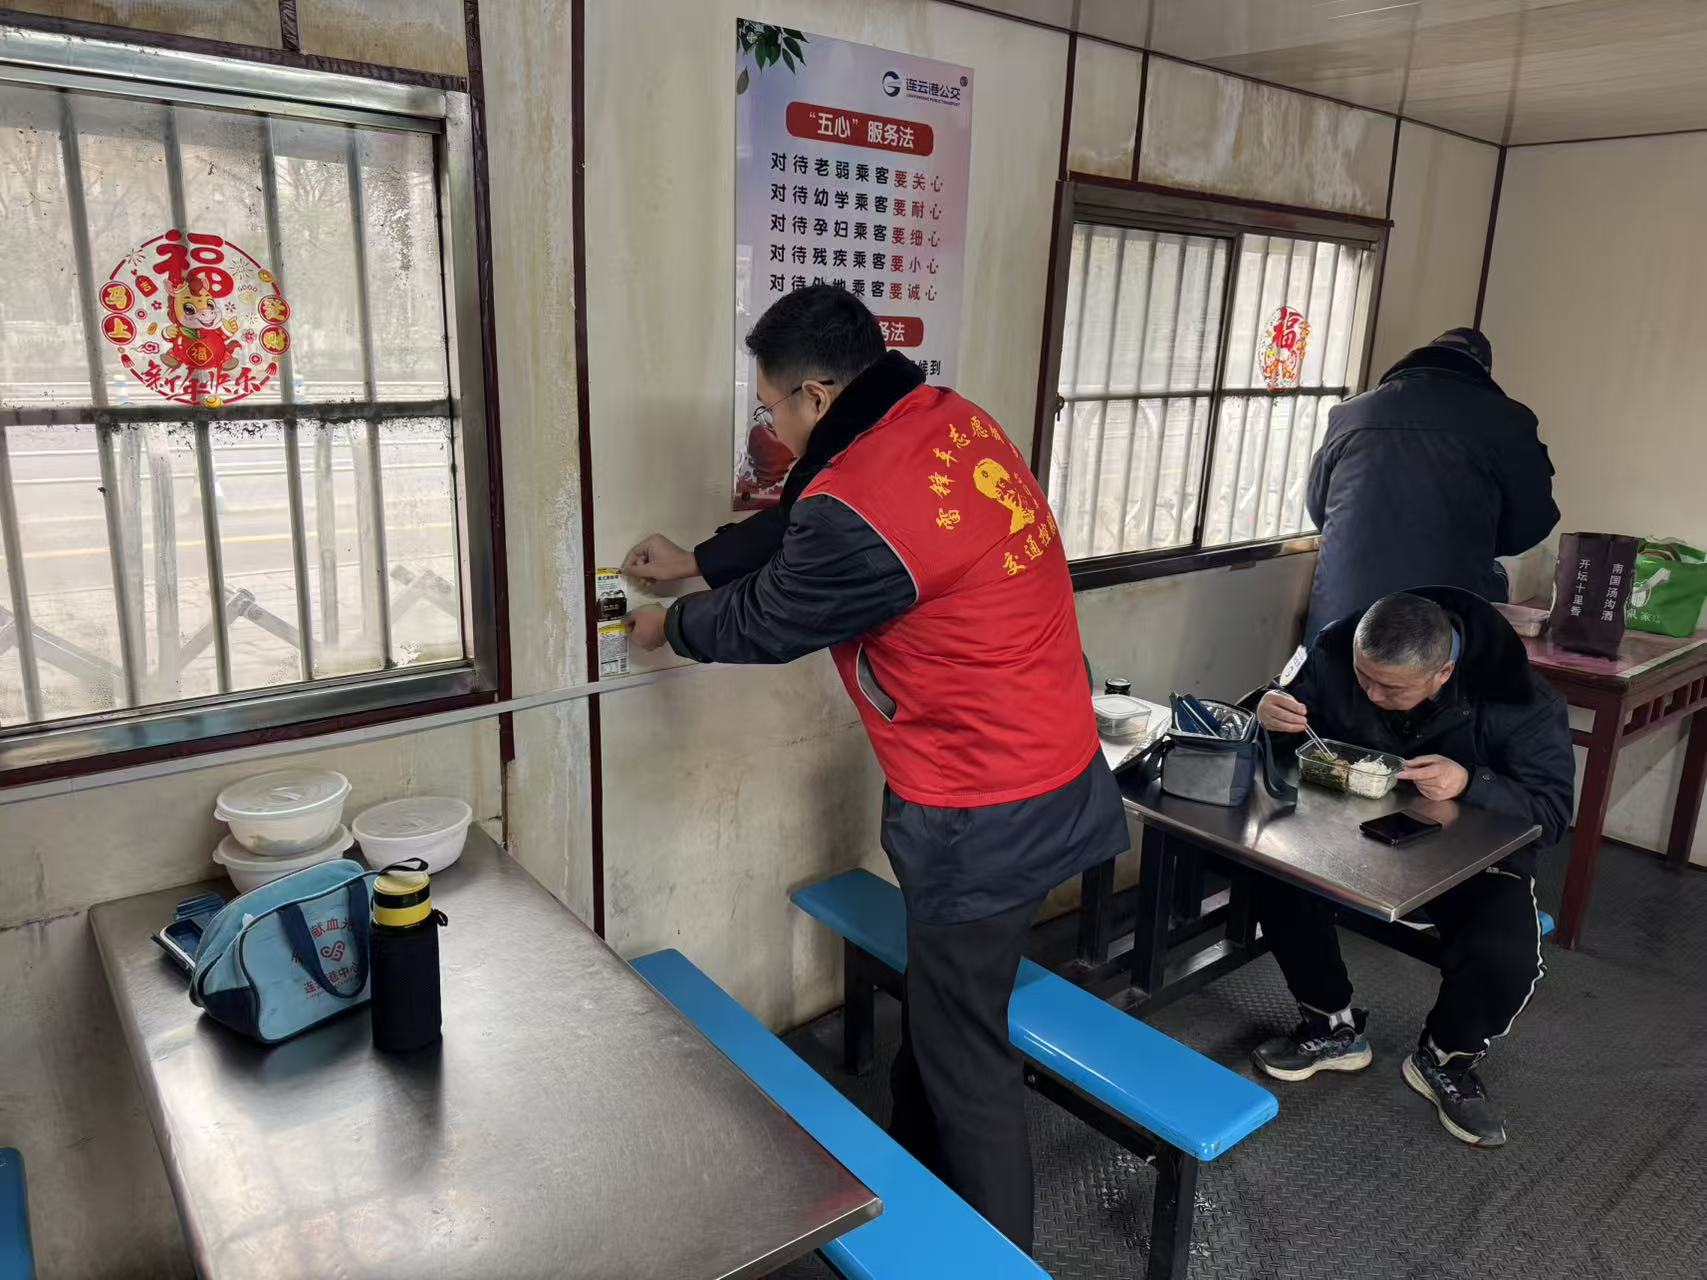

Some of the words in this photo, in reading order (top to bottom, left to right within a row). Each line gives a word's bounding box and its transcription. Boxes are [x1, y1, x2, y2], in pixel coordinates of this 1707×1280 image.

[905, 77, 961, 101] 连云港公交
[770, 152, 944, 194] 对待老弱乘客要关心
[770, 183, 942, 221] 对待幼学乘客要耐心
[770, 213, 941, 248] 对待孕妇乘客要细心
[153, 229, 235, 299] 福
[769, 243, 939, 276] 对待残疾乘客要小心
[142, 360, 260, 402] 新年快乐
[1600, 563, 1625, 622] 南国汤沟酒
